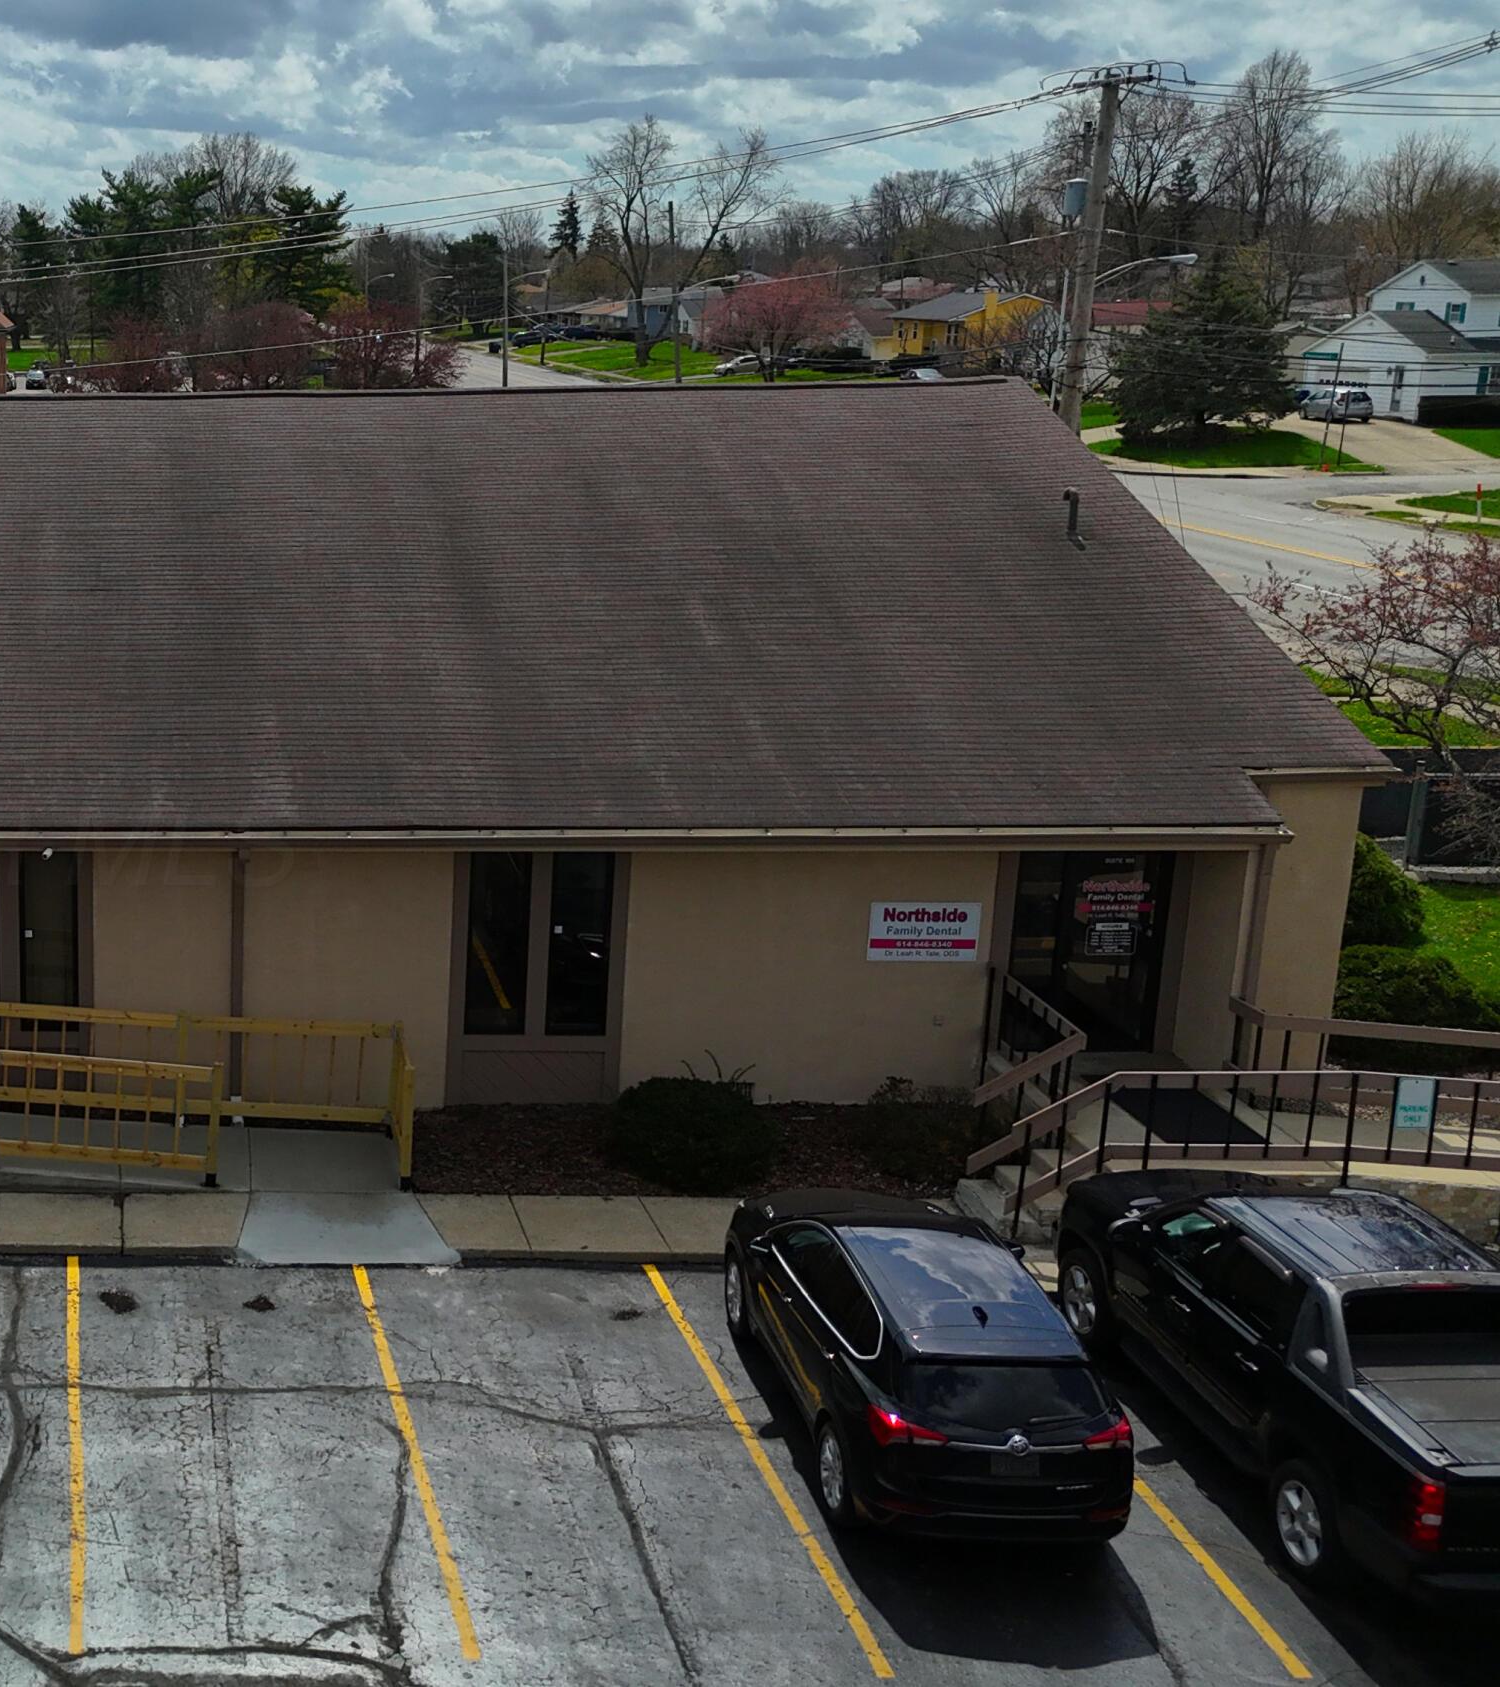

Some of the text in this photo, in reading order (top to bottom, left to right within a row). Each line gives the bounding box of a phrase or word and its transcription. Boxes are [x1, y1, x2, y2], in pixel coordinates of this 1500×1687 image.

[1082, 880, 1151, 893] Northside
[1087, 893, 1145, 902] Family Dental
[883, 907, 968, 922] Northside
[886, 925, 962, 937] Family Dental
[1399, 1105, 1428, 1113] PARKING
[1403, 1115, 1422, 1123] ONLY
